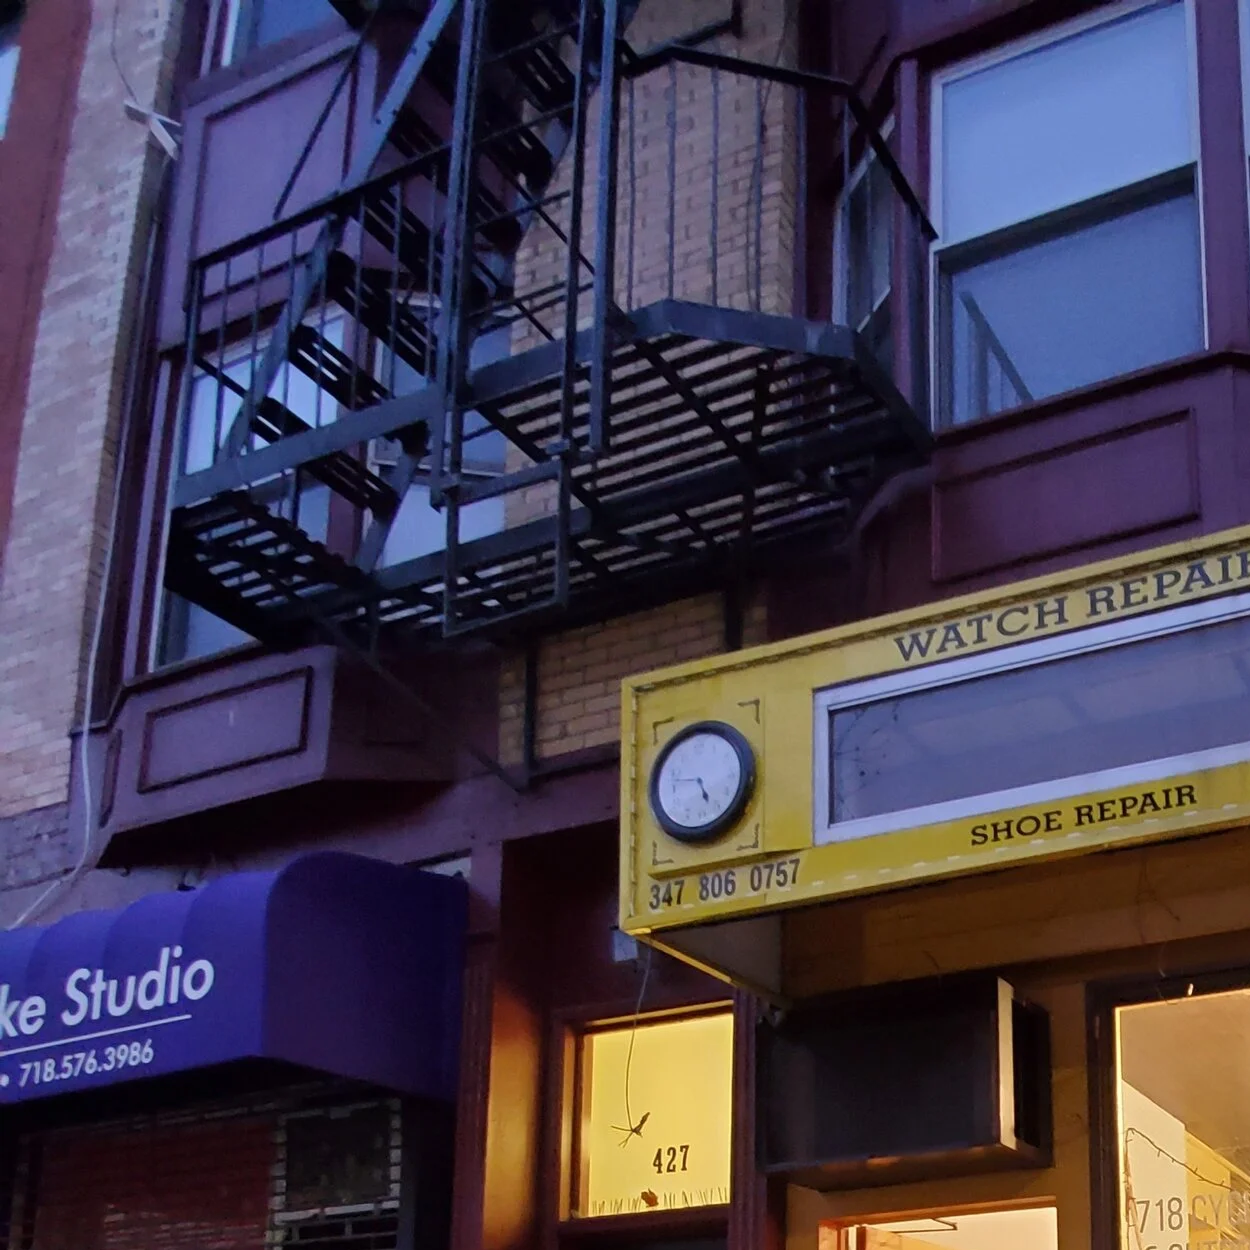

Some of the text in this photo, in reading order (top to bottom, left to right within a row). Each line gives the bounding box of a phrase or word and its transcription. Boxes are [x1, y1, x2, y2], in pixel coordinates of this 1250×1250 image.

[893, 595, 1070, 663] WATCH
[971, 785, 1198, 846] SHOE REPAIR
[649, 858, 801, 910] 347 806 0757
[60, 945, 215, 1027] Studio
[19, 1038, 154, 1088] 718.576.3986
[653, 1144, 690, 1174] 427
[1136, 1196, 1184, 1234] 718
